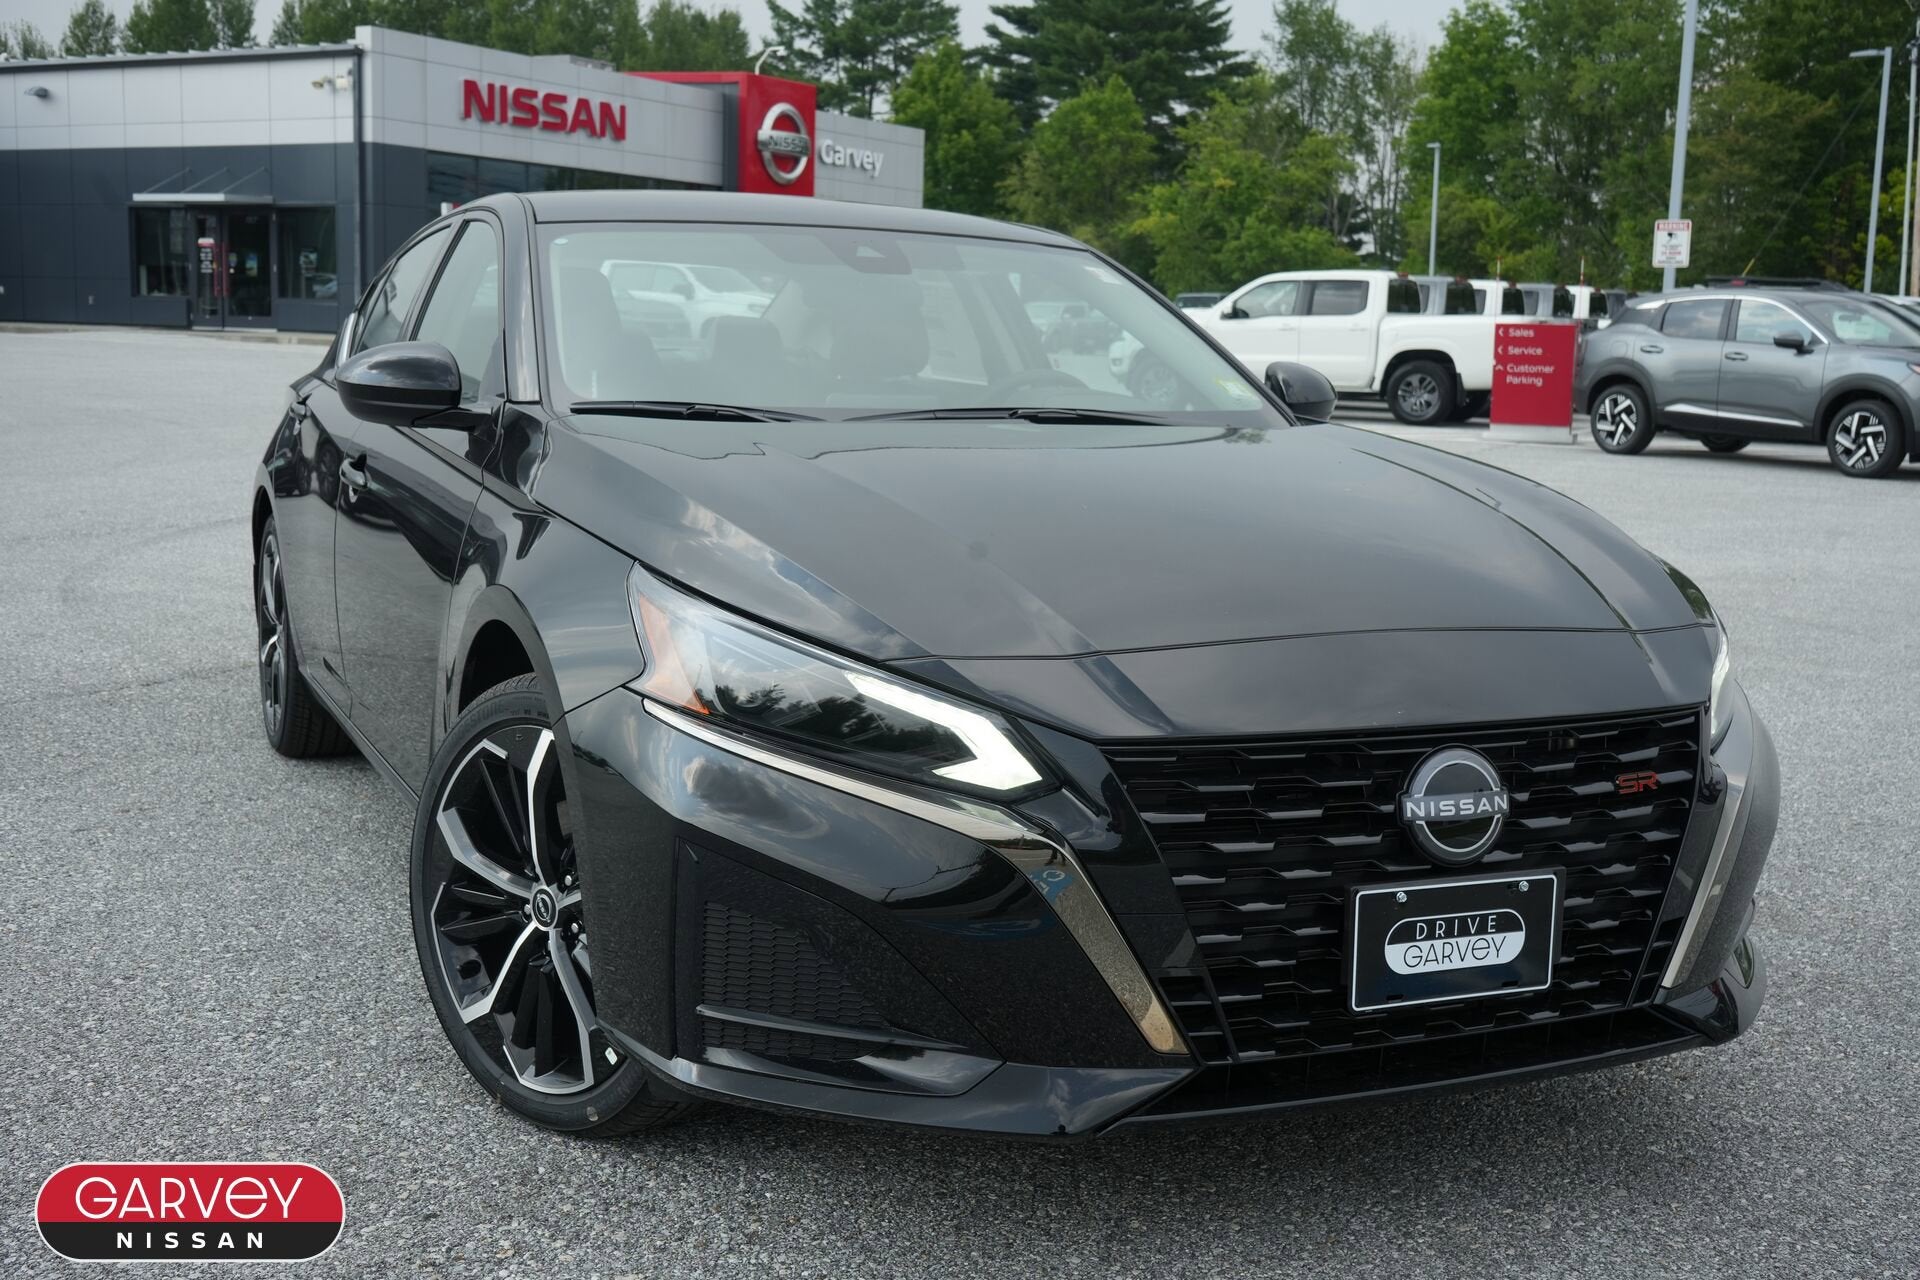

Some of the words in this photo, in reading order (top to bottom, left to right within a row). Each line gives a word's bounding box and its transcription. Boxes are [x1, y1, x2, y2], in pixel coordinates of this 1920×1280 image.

[463, 79, 626, 141] NISSAN
[820, 139, 884, 177] Garvey
[1508, 327, 1535, 338] Sales
[1507, 345, 1543, 356] Service
[1506, 363, 1555, 374] Customer
[1506, 374, 1543, 387] Parking
[1616, 771, 1658, 794] SR
[1406, 794, 1508, 817] NISSAN
[1415, 915, 1497, 940] DRIVE
